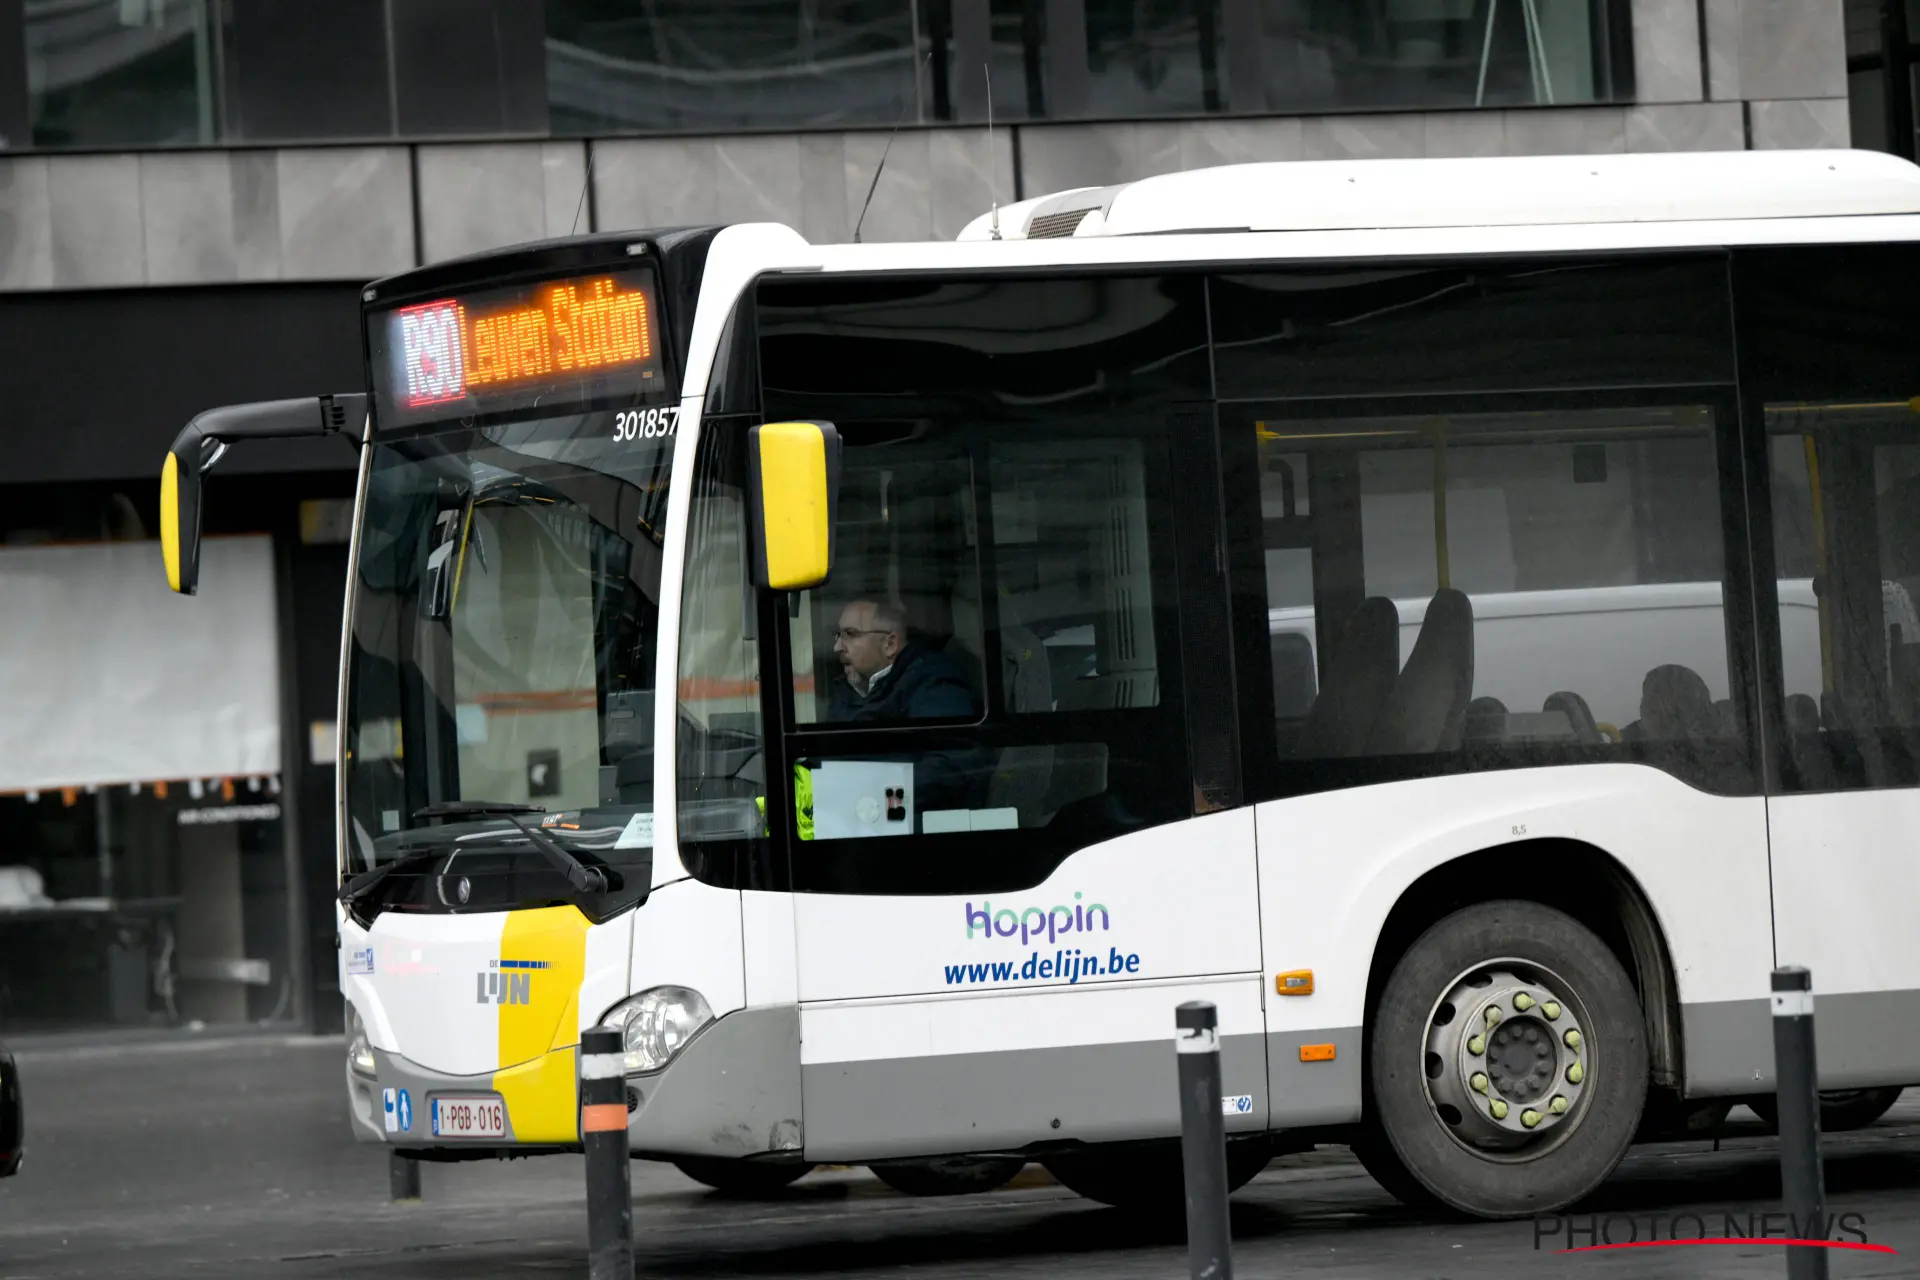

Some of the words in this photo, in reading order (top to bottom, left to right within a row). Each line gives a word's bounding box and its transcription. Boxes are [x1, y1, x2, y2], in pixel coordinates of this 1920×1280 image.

[458, 306, 551, 386] Leuven
[551, 279, 650, 370] Station
[613, 406, 681, 442] 301857
[944, 946, 1140, 985] www.delijn.be
